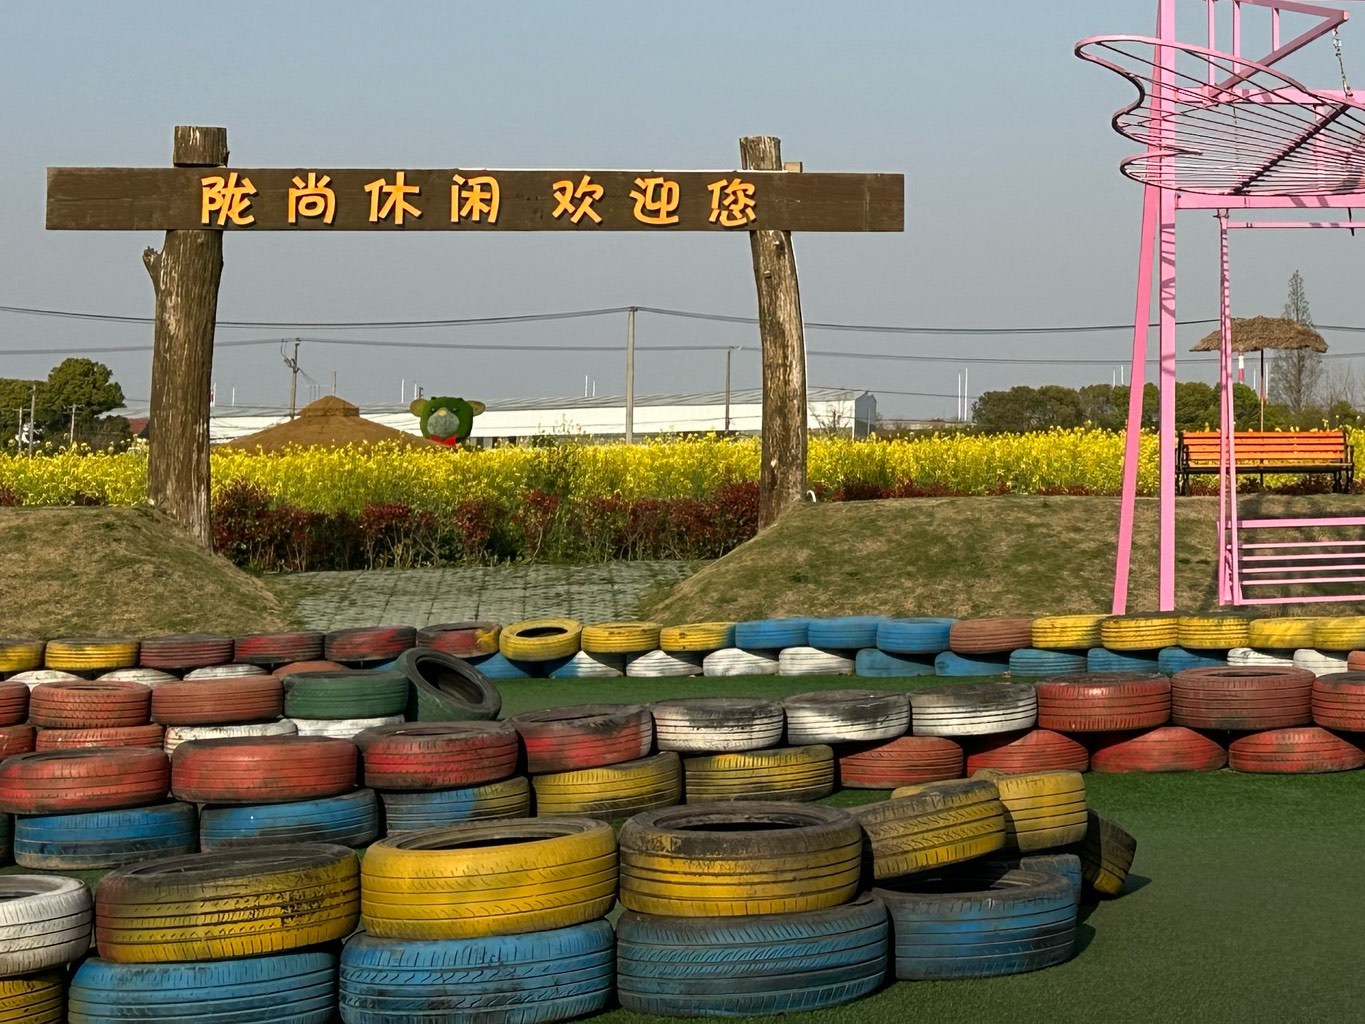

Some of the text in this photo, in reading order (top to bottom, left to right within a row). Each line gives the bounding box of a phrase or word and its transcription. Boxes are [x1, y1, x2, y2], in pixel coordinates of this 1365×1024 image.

[200, 171, 757, 227] 陇尚休闲 欢迎您
